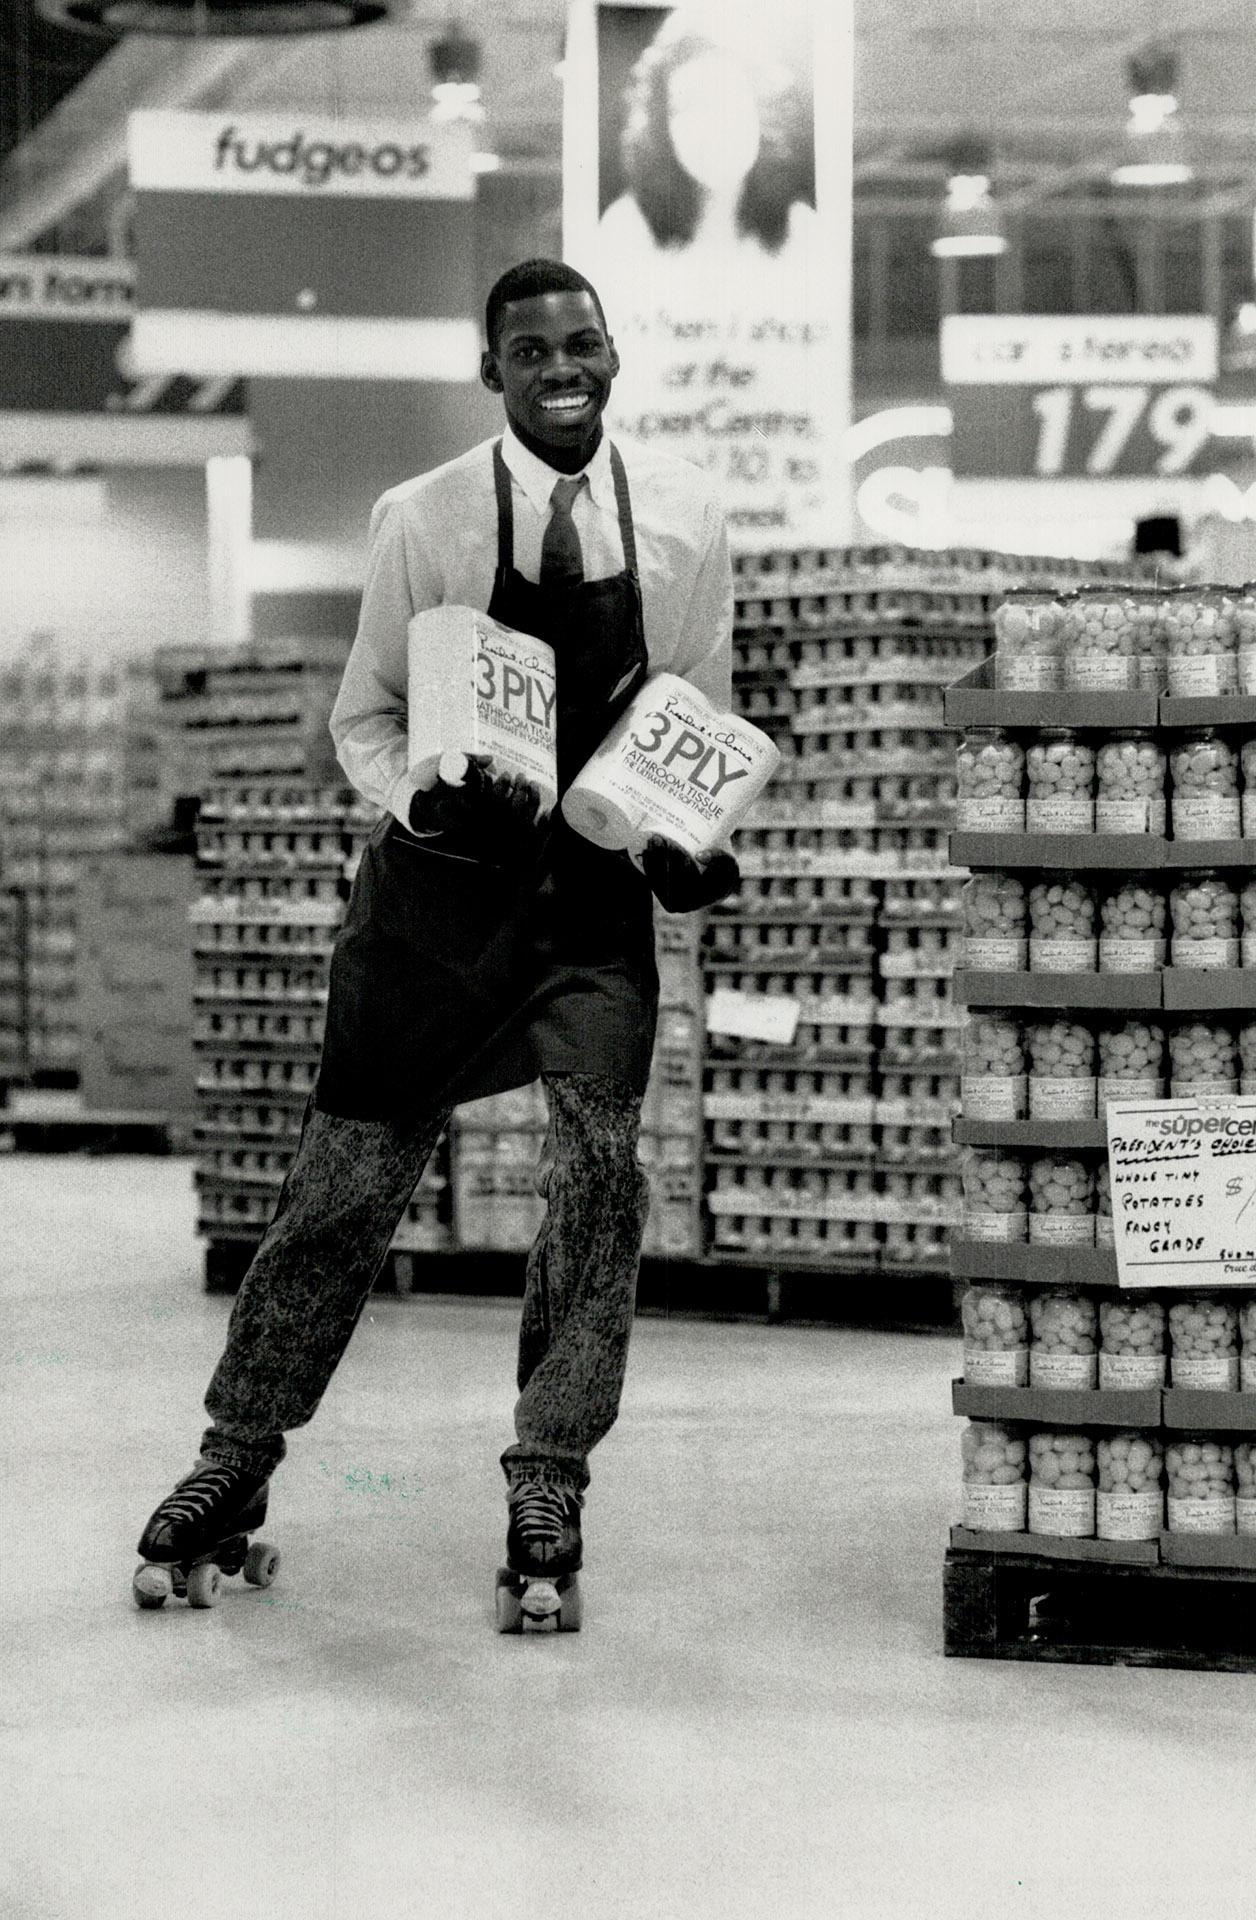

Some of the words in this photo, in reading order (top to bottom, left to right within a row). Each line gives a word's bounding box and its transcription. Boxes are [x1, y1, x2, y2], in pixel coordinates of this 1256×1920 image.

[214, 126, 430, 187] fudgeos
[1033, 385, 1216, 475] 179
[470, 652, 496, 701] 3
[502, 664, 557, 730] PLY
[476, 701, 529, 736] ATHROOM
[629, 711, 671, 753] 3
[662, 729, 749, 797] PLY
[687, 785, 724, 819] TISSUE
[1111, 1137, 1201, 1155] PRESIDENT'S
[1122, 1192, 1204, 1211] POTATOES
[1125, 1219, 1171, 1238] FANCY
[1149, 1237, 1204, 1253] GRADE
